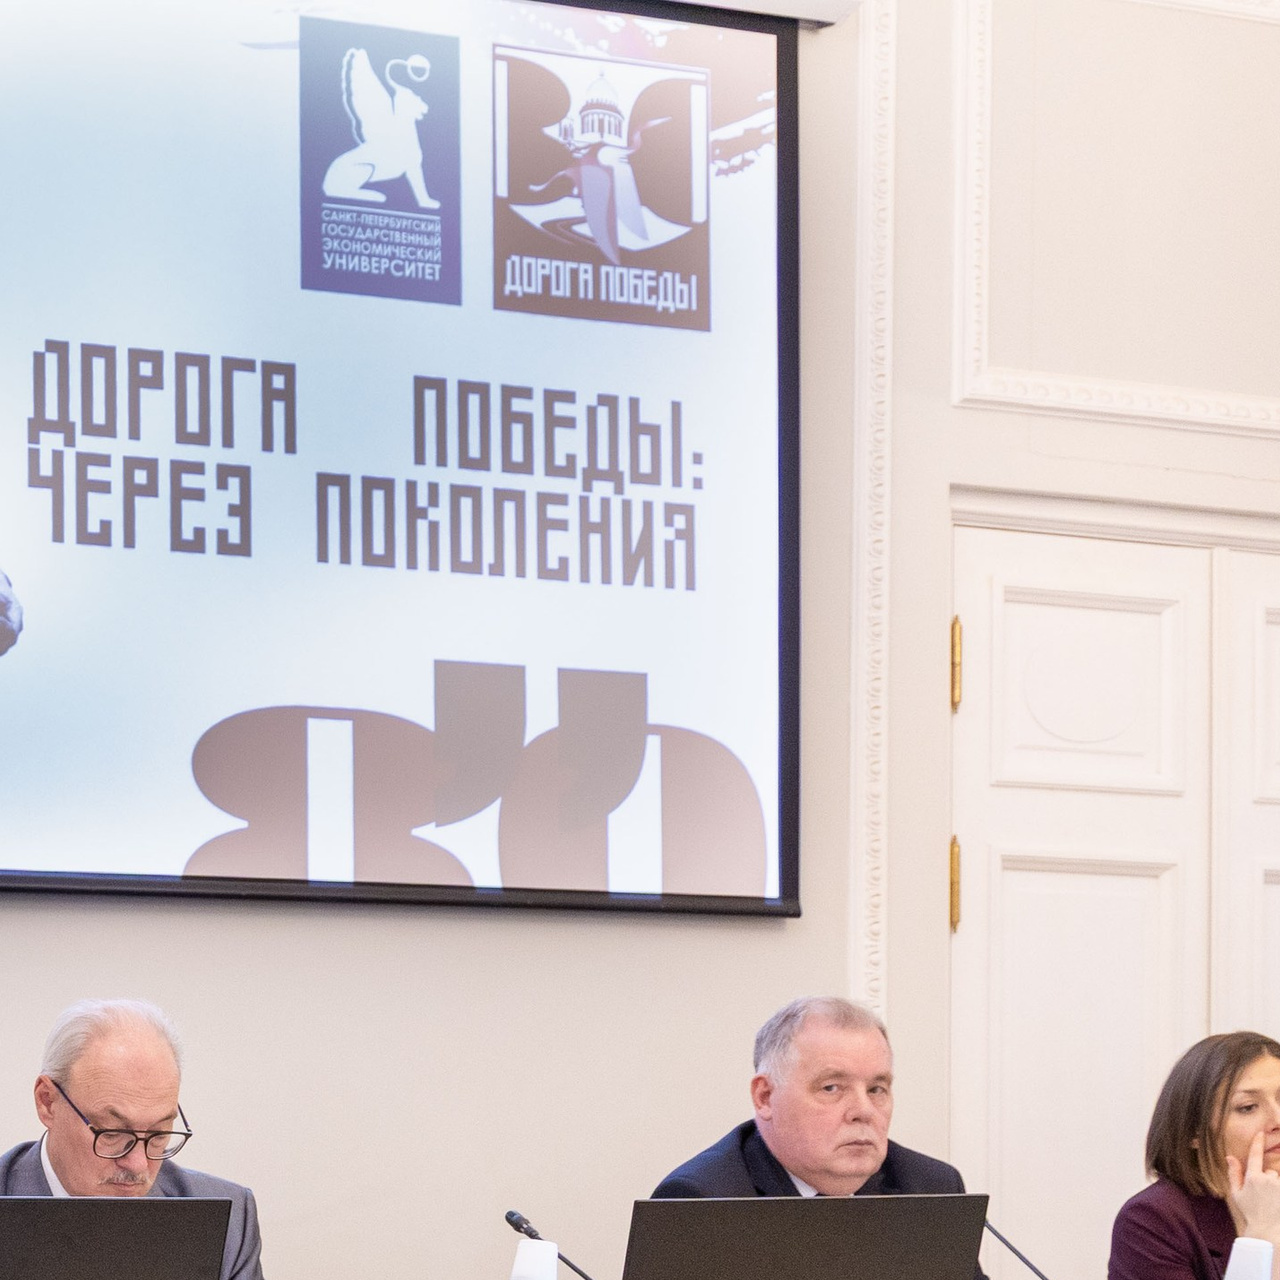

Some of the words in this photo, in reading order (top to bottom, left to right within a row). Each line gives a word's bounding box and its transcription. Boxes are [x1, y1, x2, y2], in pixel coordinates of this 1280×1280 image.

[322, 210, 441, 233] САНКТ-ПЕТЕРБУРГСКИЙ
[322, 223, 441, 246] ГОСУДАРСТВЕННЫЙ
[322, 238, 441, 261] ЭКОНОМИЧЕСКИЙ
[322, 252, 441, 280] УНИВЕРСИТЕТ
[504, 255, 594, 299] ДОРОГА
[600, 265, 697, 313] ПОБЕДЫ
[28, 339, 297, 455] ДОРОГА
[413, 375, 704, 496] ПОБЕДЫ:
[28, 447, 252, 558] ЧЕРЕЗ
[316, 471, 696, 591] ПОКОЛЕНИЯ
